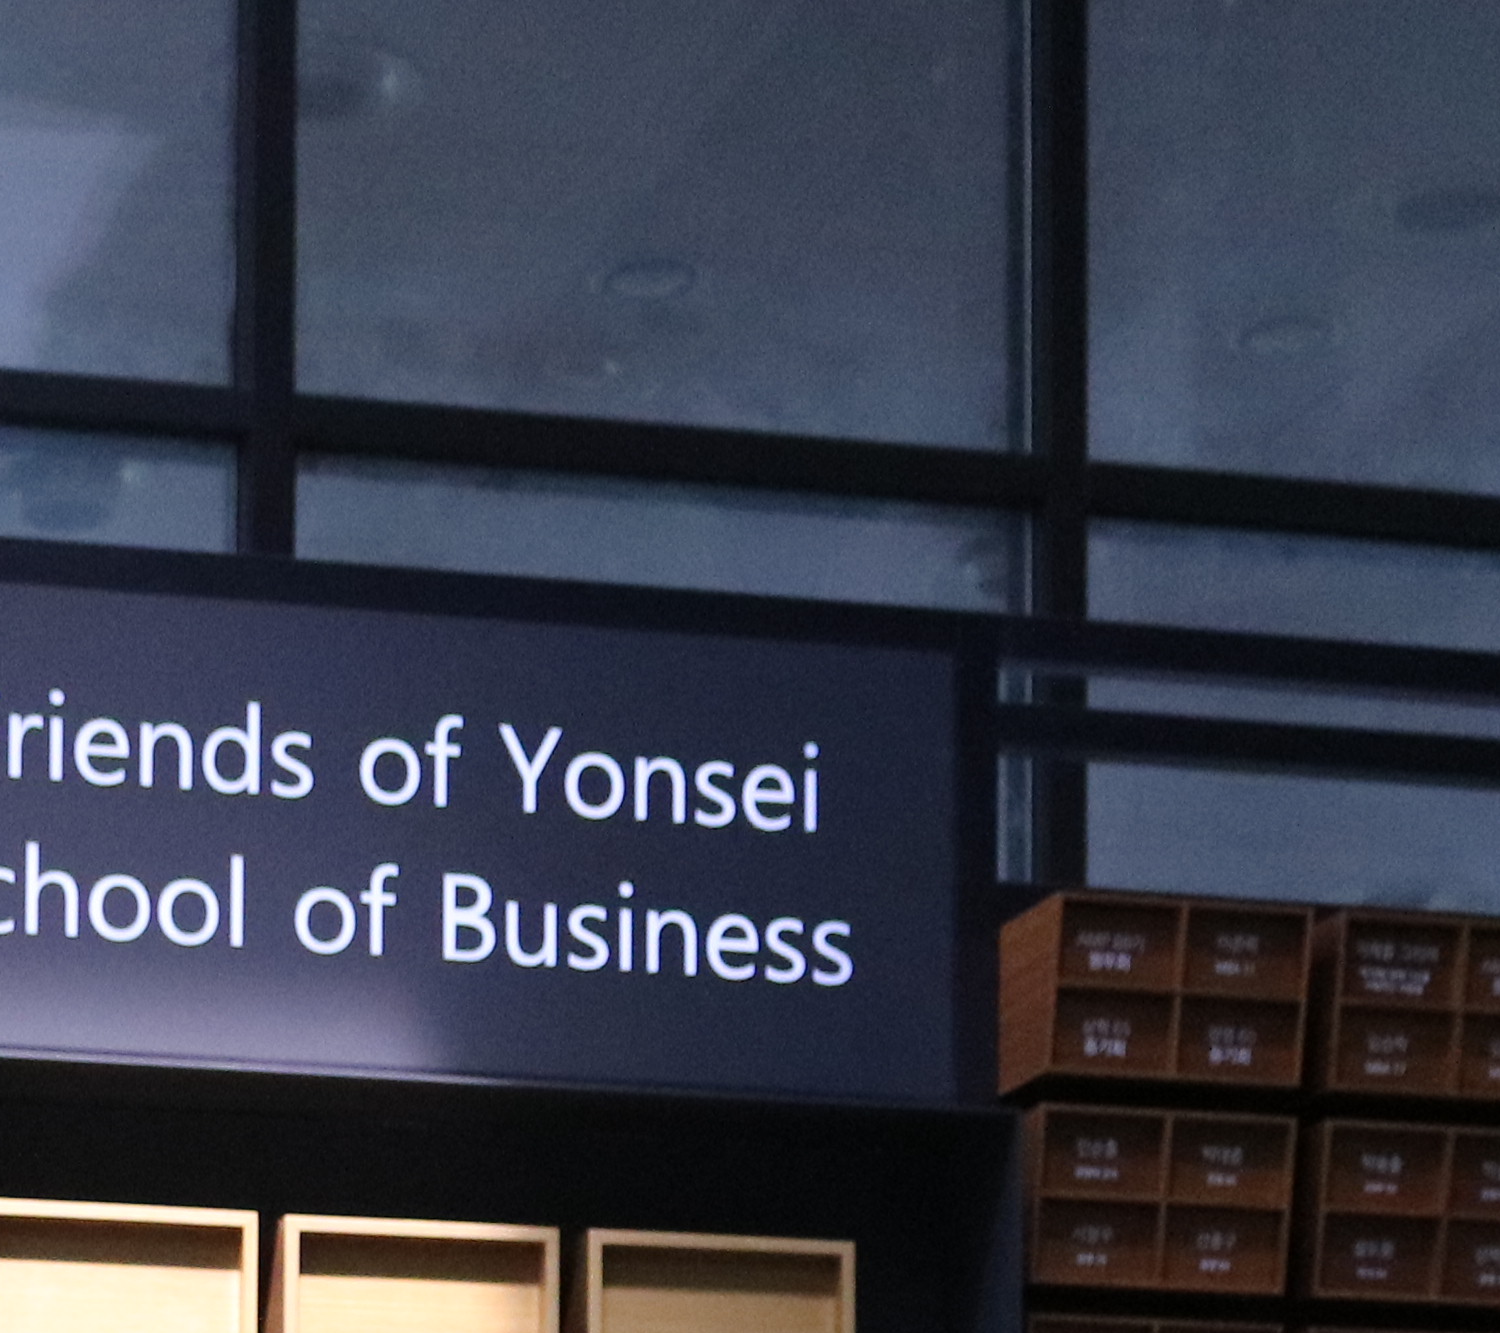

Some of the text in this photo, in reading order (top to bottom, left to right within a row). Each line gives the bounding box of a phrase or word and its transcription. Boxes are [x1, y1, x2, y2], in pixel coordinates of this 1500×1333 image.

[358, 715, 465, 808] of
[499, 722, 819, 833] Yonsei
[293, 862, 400, 957] of
[441, 872, 853, 987] Business
